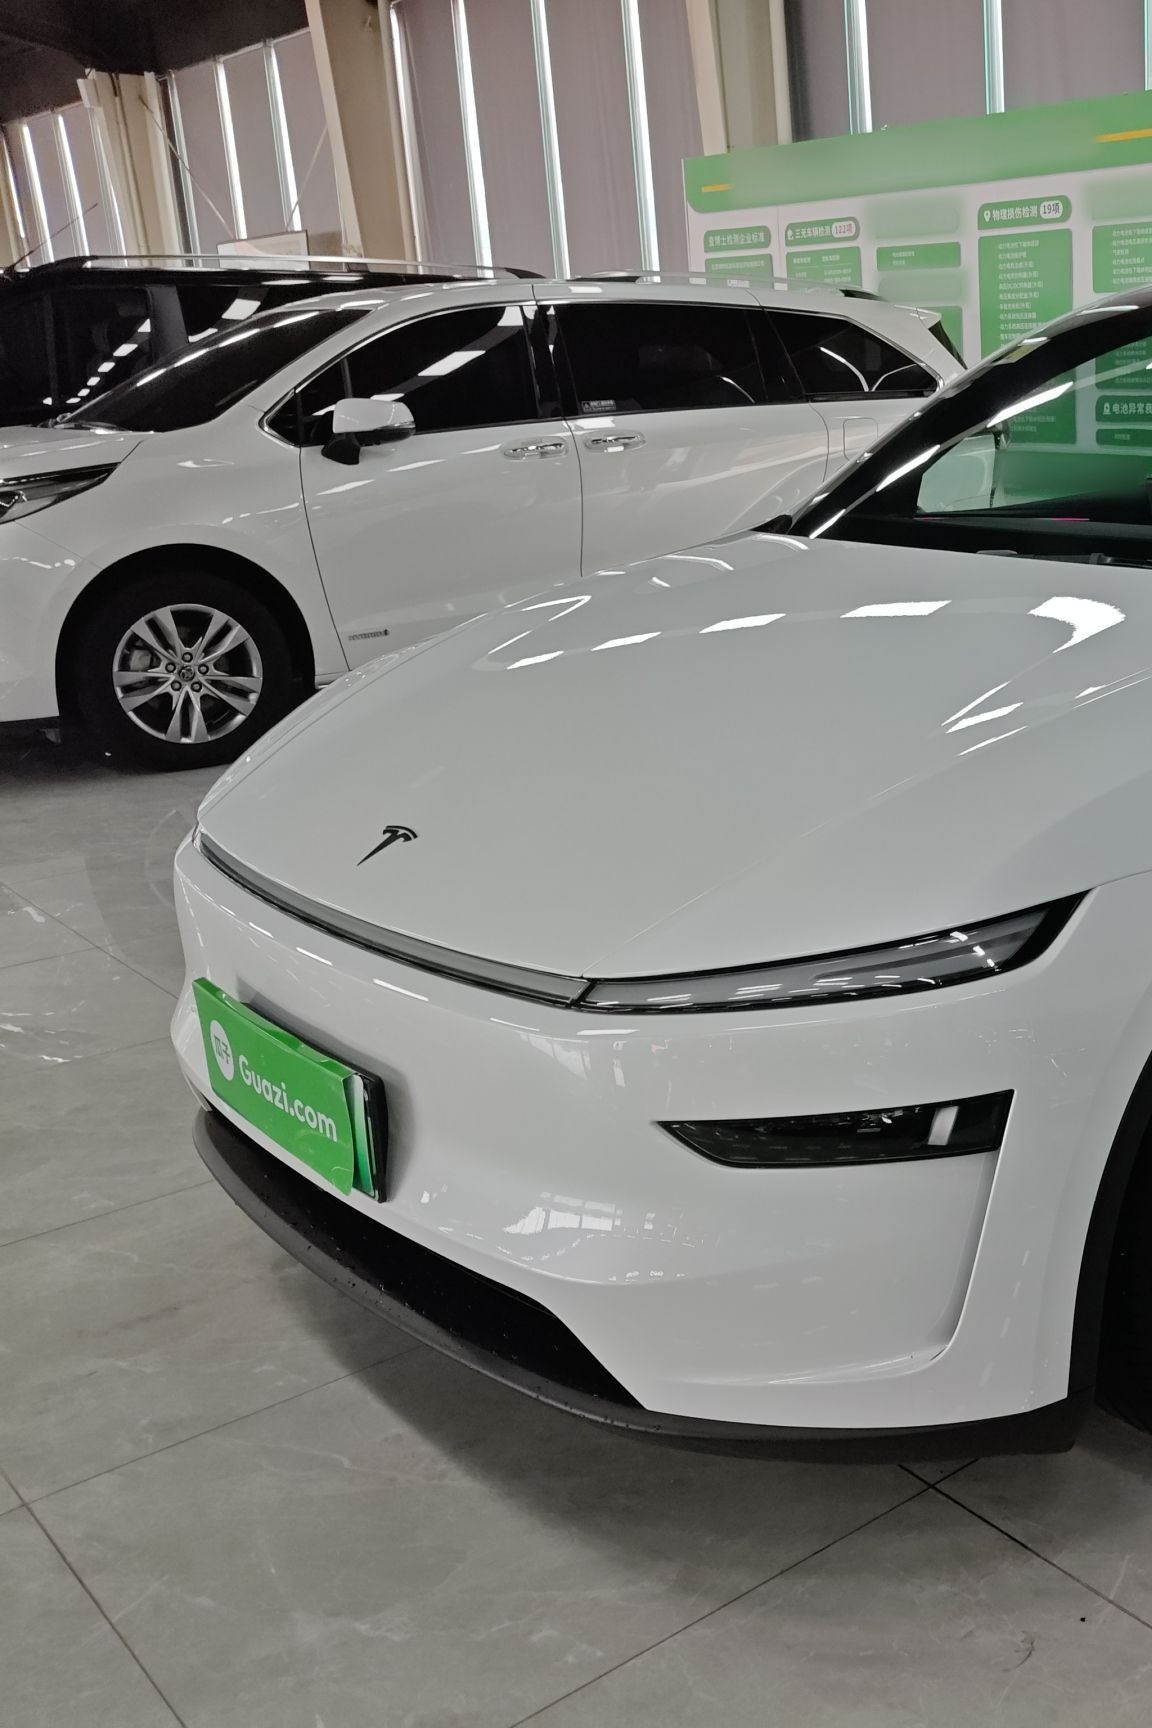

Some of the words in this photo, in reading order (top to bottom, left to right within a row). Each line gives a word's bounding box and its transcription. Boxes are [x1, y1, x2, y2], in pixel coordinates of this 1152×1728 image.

[992, 205, 1038, 221] 物理损伤检测
[1042, 202, 1060, 215] 19项
[213, 1034, 232, 1065] 瓜子
[238, 1054, 338, 1144] Guazi.com
